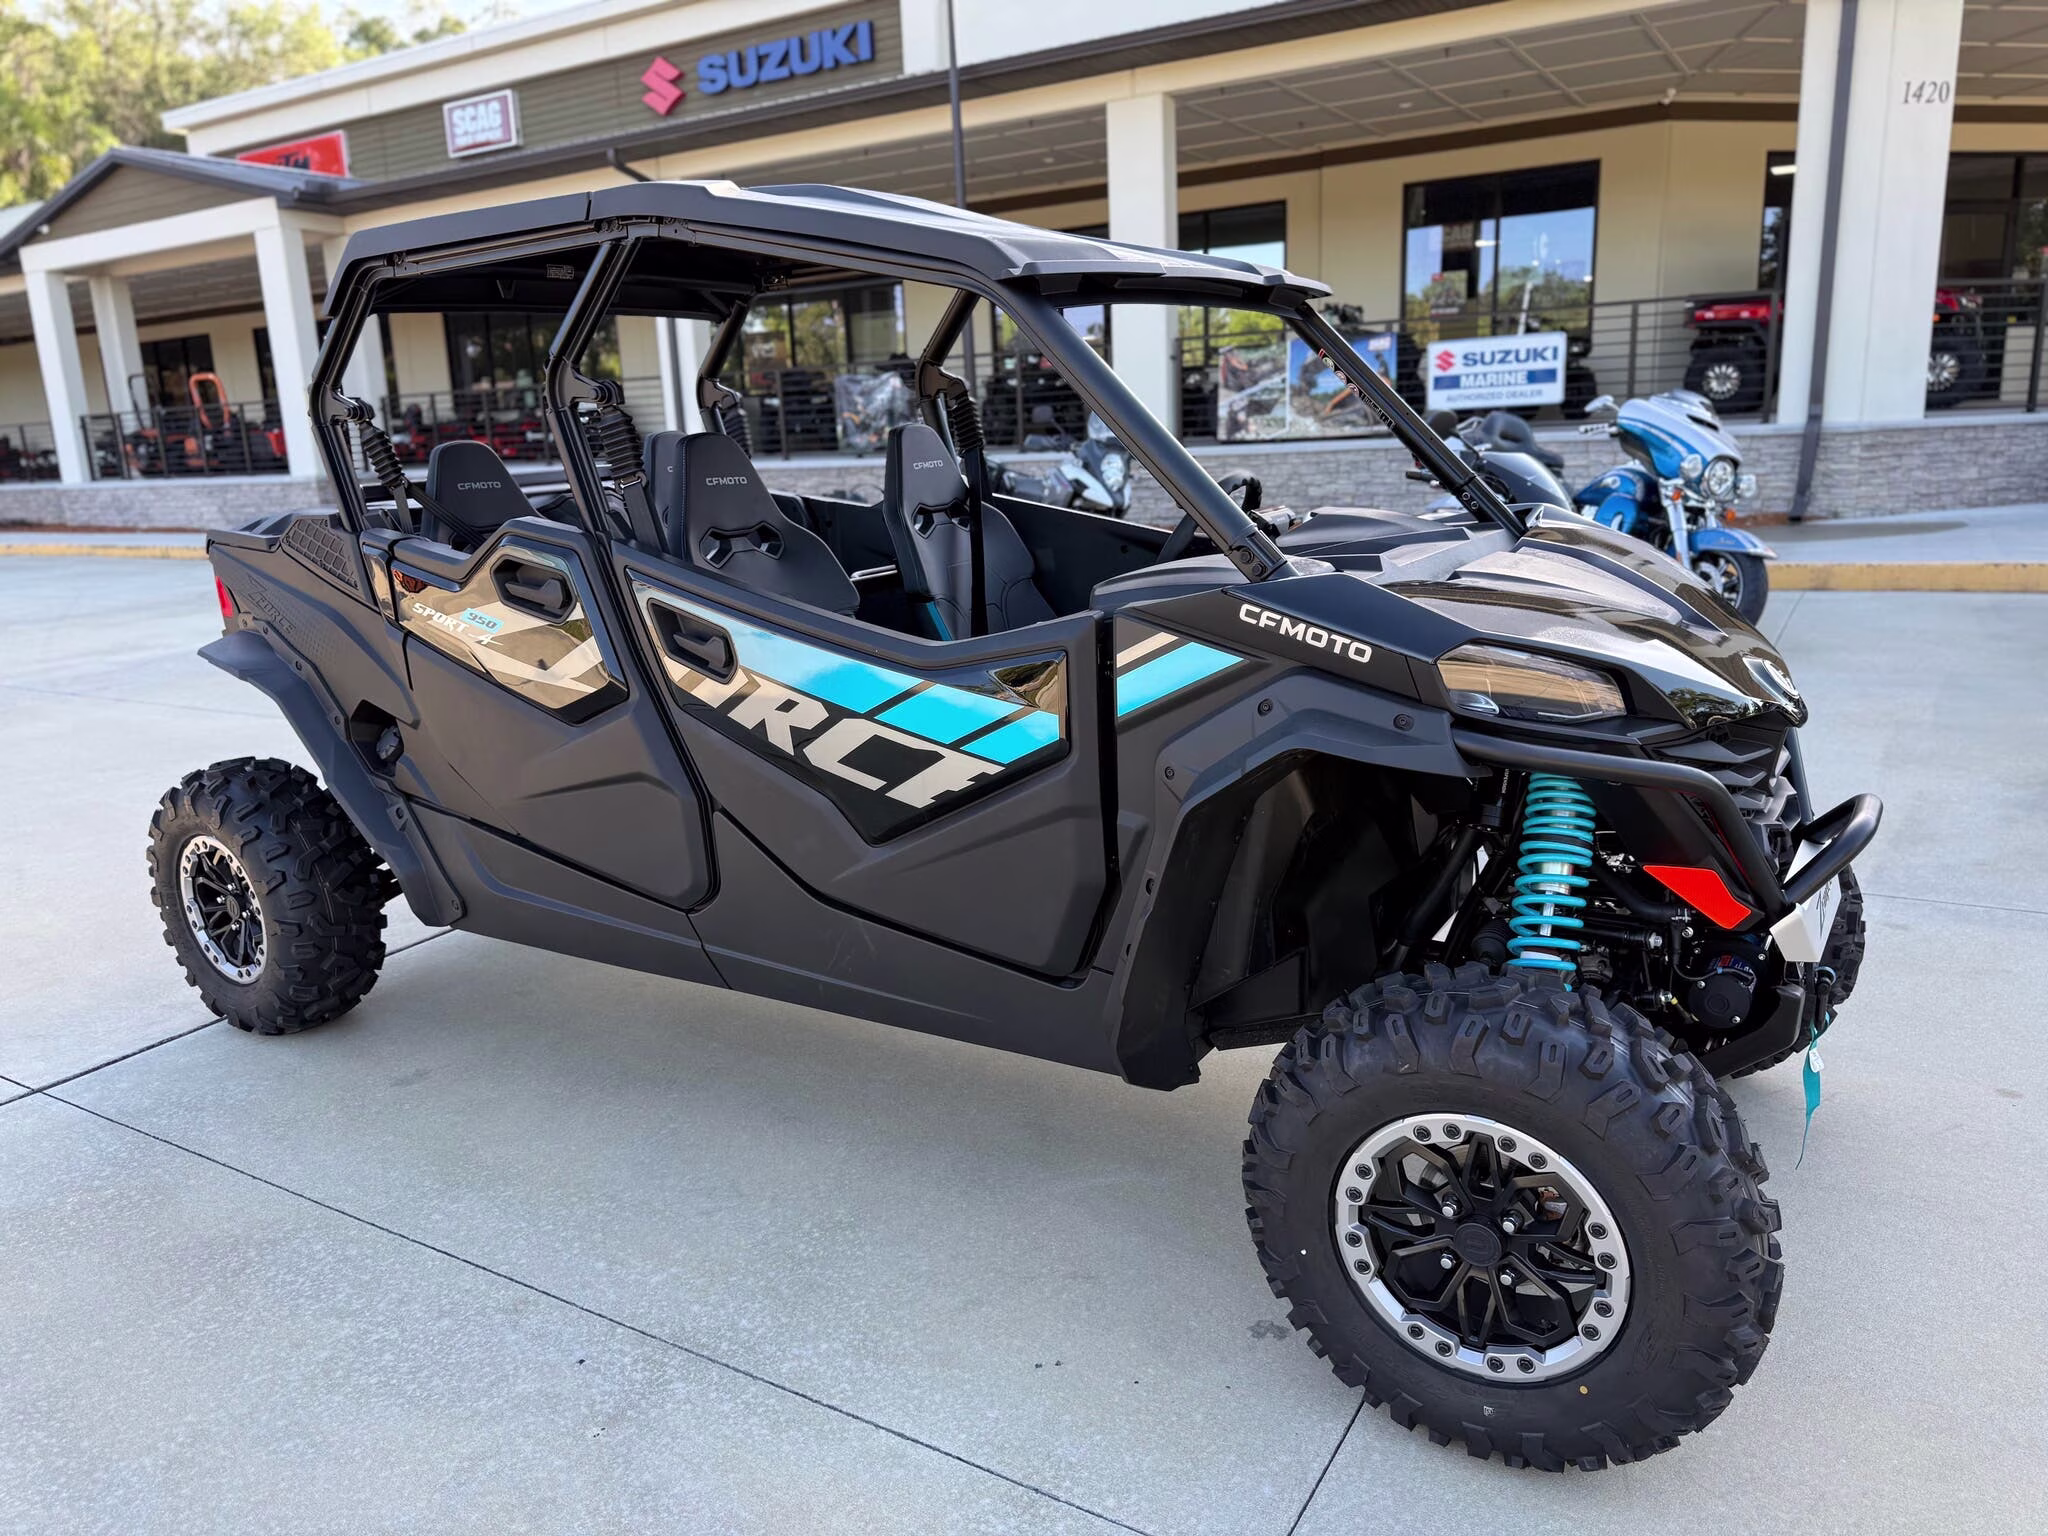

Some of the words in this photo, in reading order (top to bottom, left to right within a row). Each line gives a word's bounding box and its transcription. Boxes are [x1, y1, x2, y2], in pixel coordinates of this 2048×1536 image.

[697, 20, 873, 95] SUZUKI
[1902, 80, 1950, 105] 1420
[452, 99, 503, 135] SCAG
[1462, 346, 1559, 367] SUZUKI
[1460, 370, 1528, 389] MARINE
[1505, 389, 1543, 400] DEALER
[913, 459, 944, 470] CFMOTO
[457, 481, 502, 491] CFMOTO
[705, 476, 748, 486] CFMOTO
[412, 602, 470, 634] SPORT
[467, 612, 498, 629] 950
[1239, 603, 1373, 664] CFMOTO
